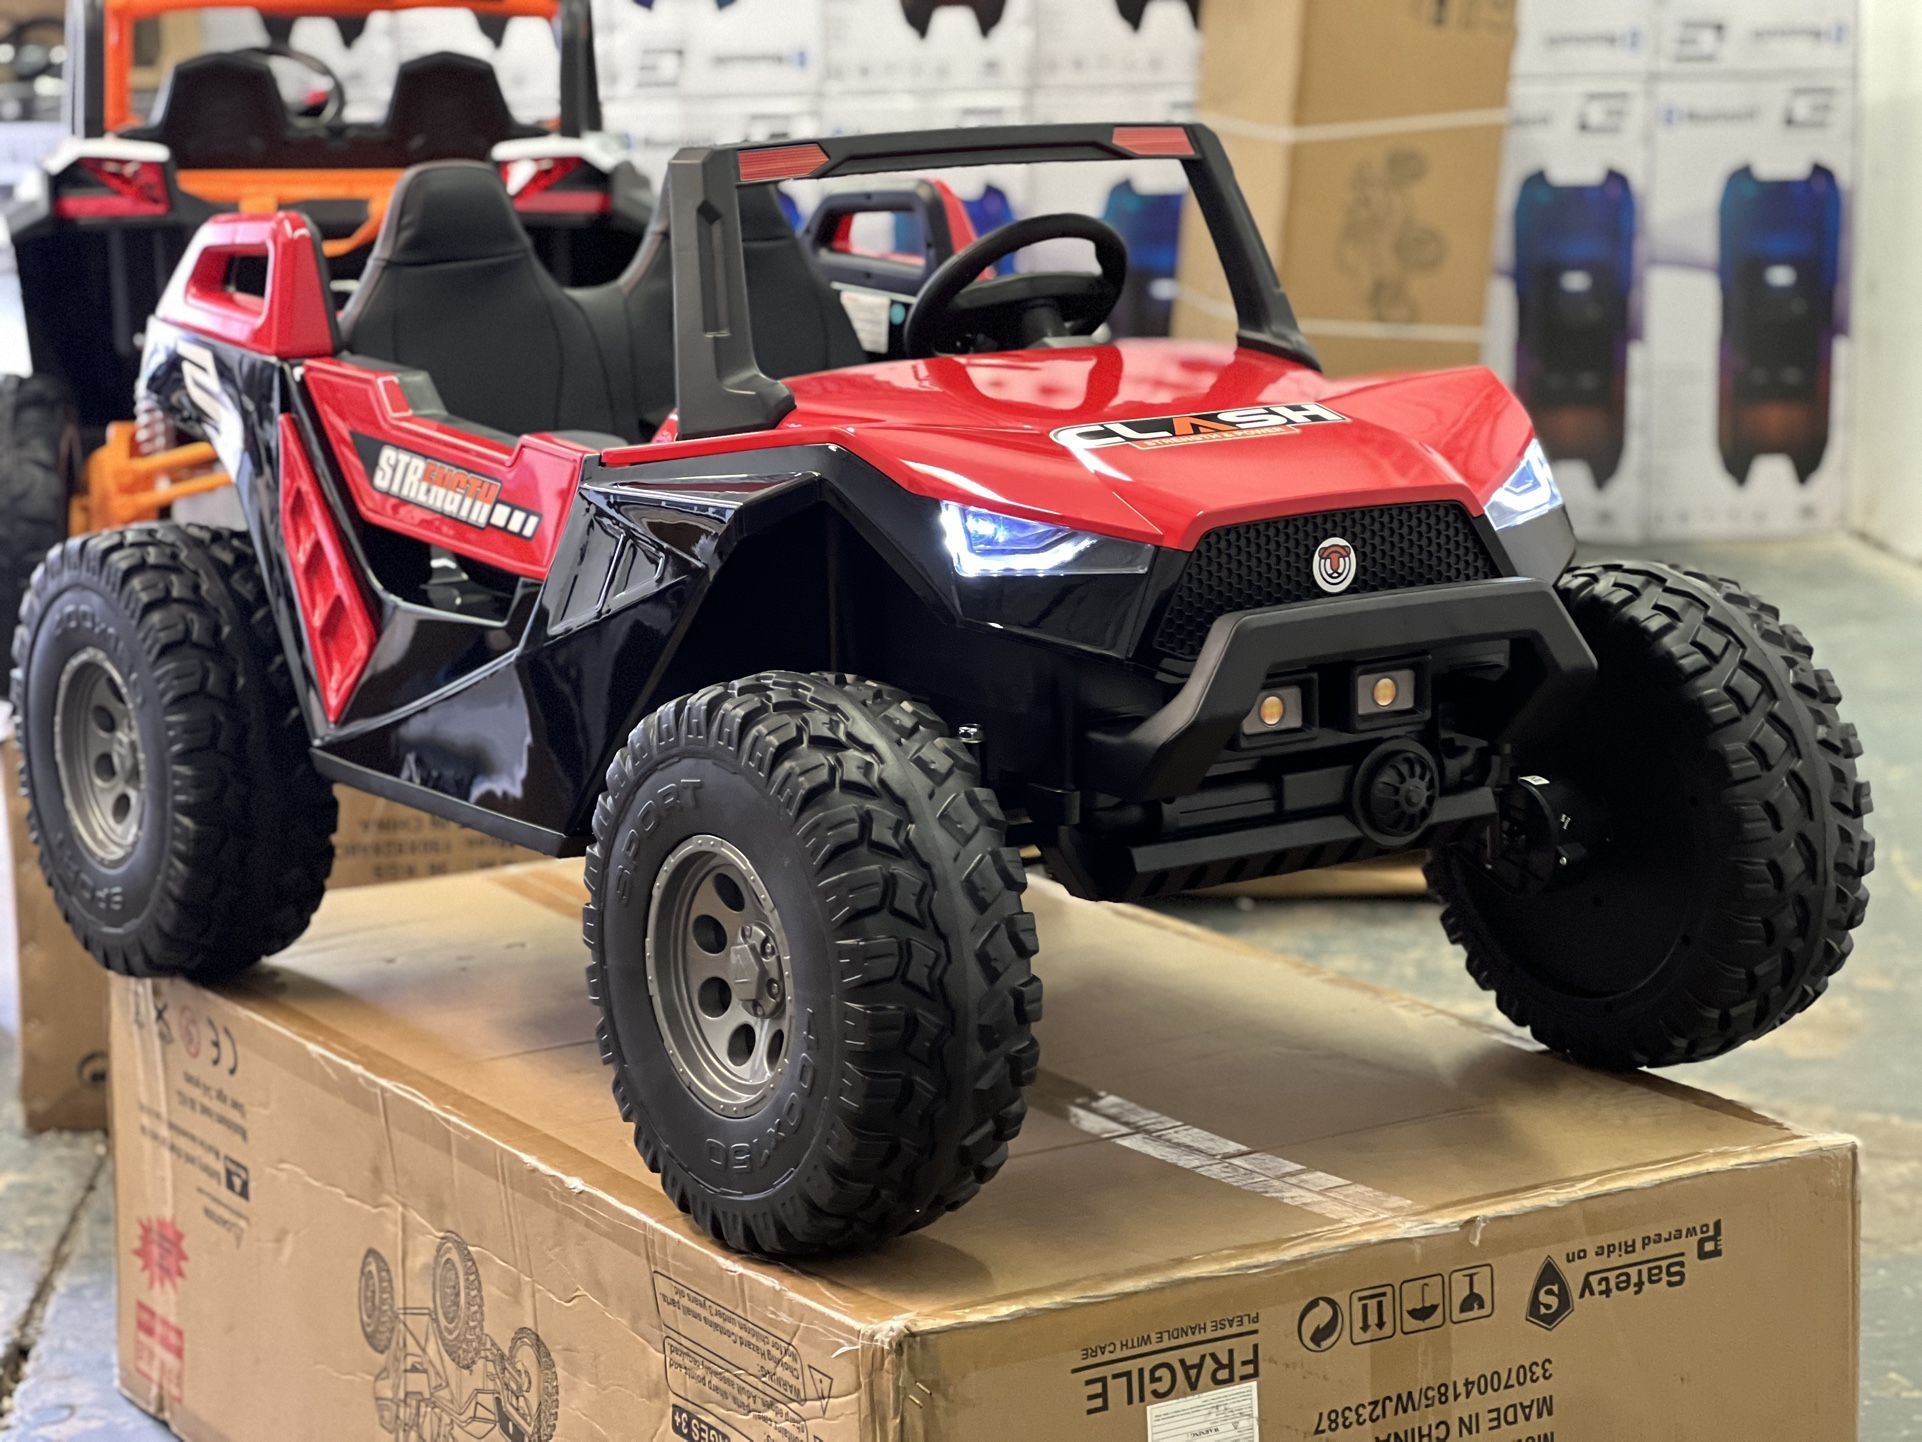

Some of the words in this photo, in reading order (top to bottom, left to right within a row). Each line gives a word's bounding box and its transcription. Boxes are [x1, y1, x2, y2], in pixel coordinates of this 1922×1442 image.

[1058, 403, 1344, 449] CLASH
[1144, 433, 1221, 447] STRENGTH
[1234, 427, 1285, 439] POWER
[373, 444, 501, 528] STRENGTH
[616, 778, 704, 903] SPORT
[1566, 1248, 1587, 1263] on
[1594, 1238, 1636, 1258] Ride
[1642, 1218, 1722, 1261] Powered
[1578, 1260, 1686, 1299] Safety
[1155, 1320, 1206, 1344] HANDLE
[1210, 1312, 1259, 1332] PLEASE
[1081, 1341, 1116, 1361] CARE
[1120, 1334, 1152, 1352] WITH
[1084, 1343, 1260, 1415] FRAGILE
[1313, 1358, 1553, 1435] 3307004185/WJ23387
[1458, 1412, 1480, 1438] IN
[1487, 1394, 1554, 1432] MADE
